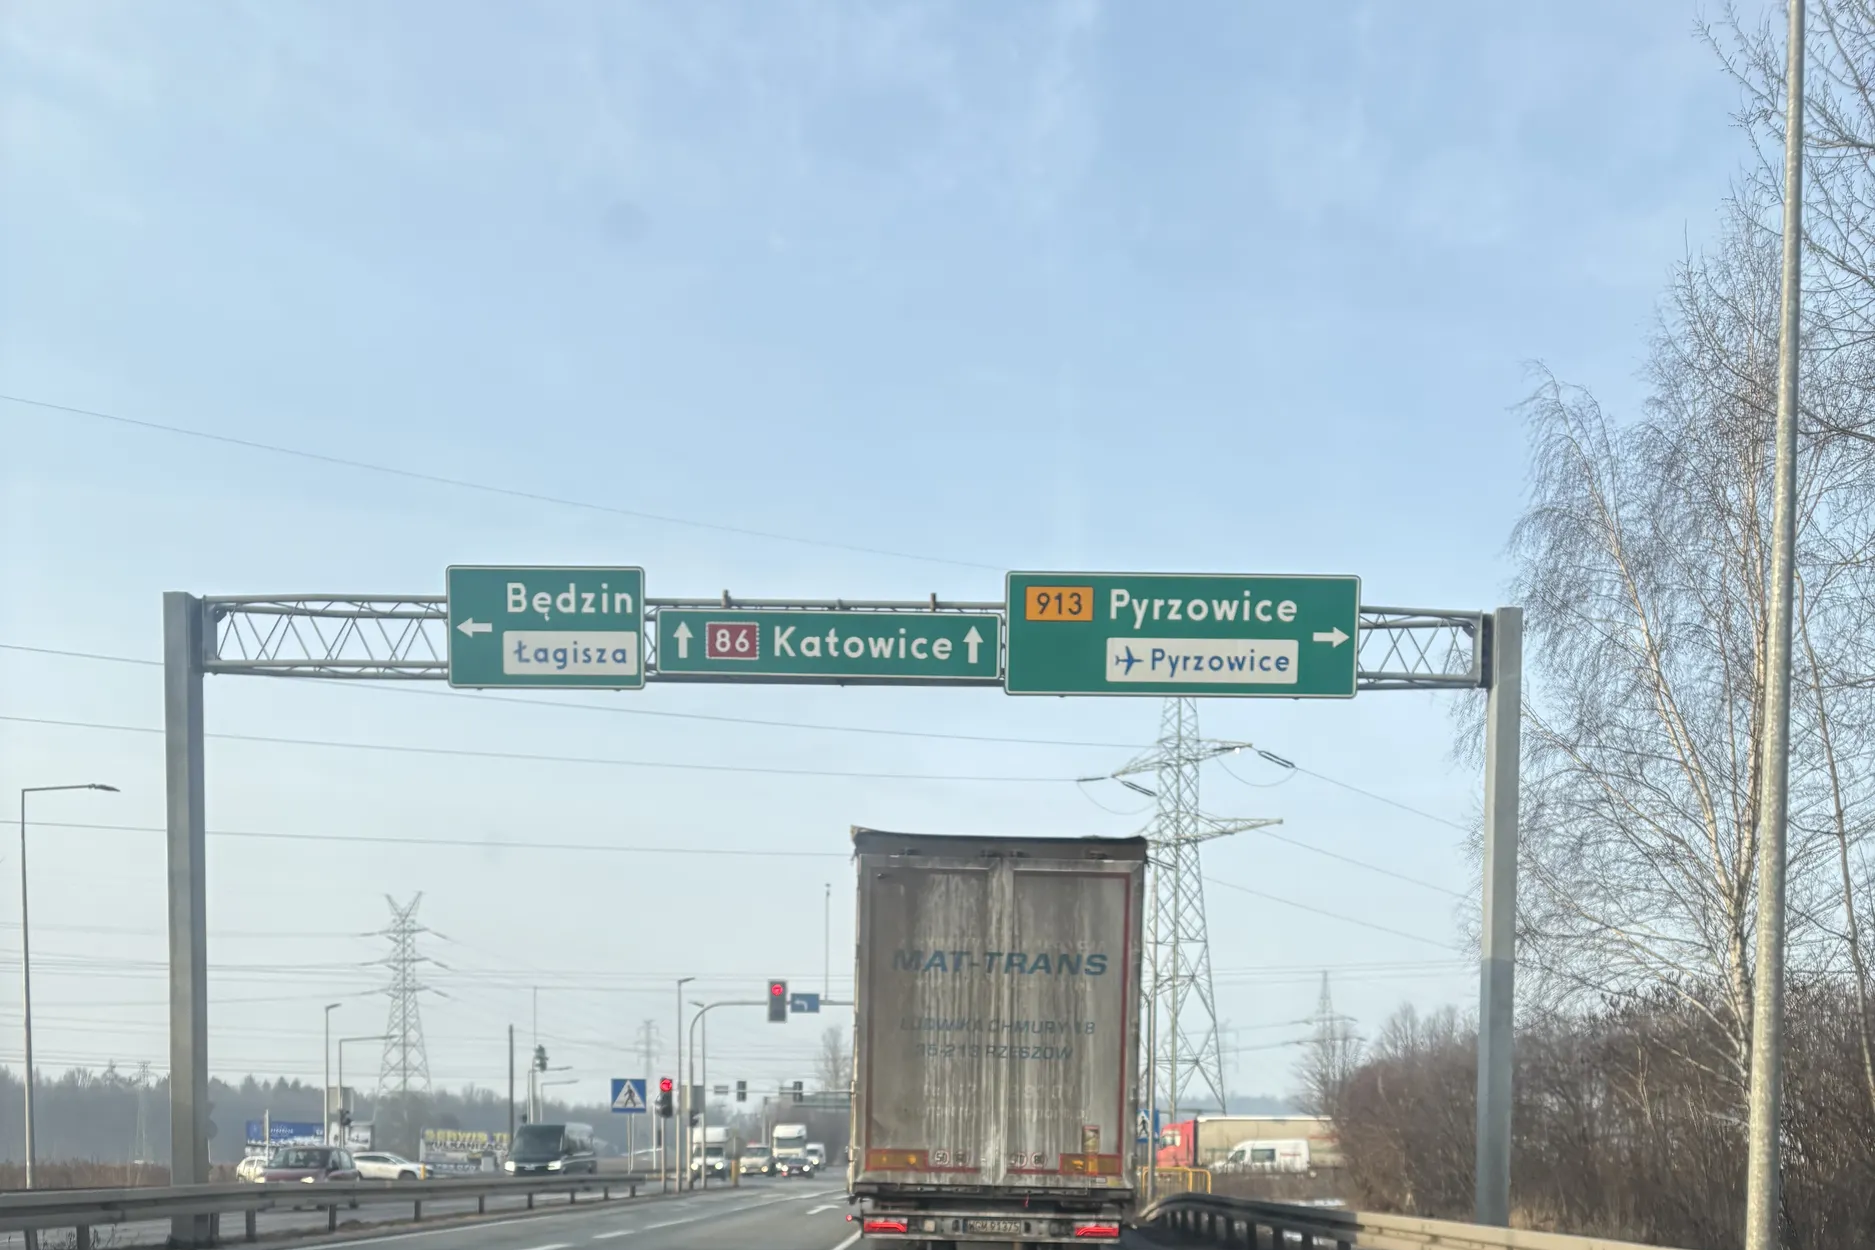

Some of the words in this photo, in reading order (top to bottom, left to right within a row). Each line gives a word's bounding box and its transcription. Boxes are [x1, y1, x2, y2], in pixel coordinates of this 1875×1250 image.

[506, 582, 633, 621] Będzin
[1036, 593, 1083, 615] 913
[1110, 588, 1298, 630] Pyrzowice
[513, 640, 627, 670] Łagisza
[715, 629, 750, 653] 86
[774, 626, 953, 660] Katowice
[1151, 648, 1290, 678] Pyrzowice
[892, 949, 1109, 976] MAT-TRANS
